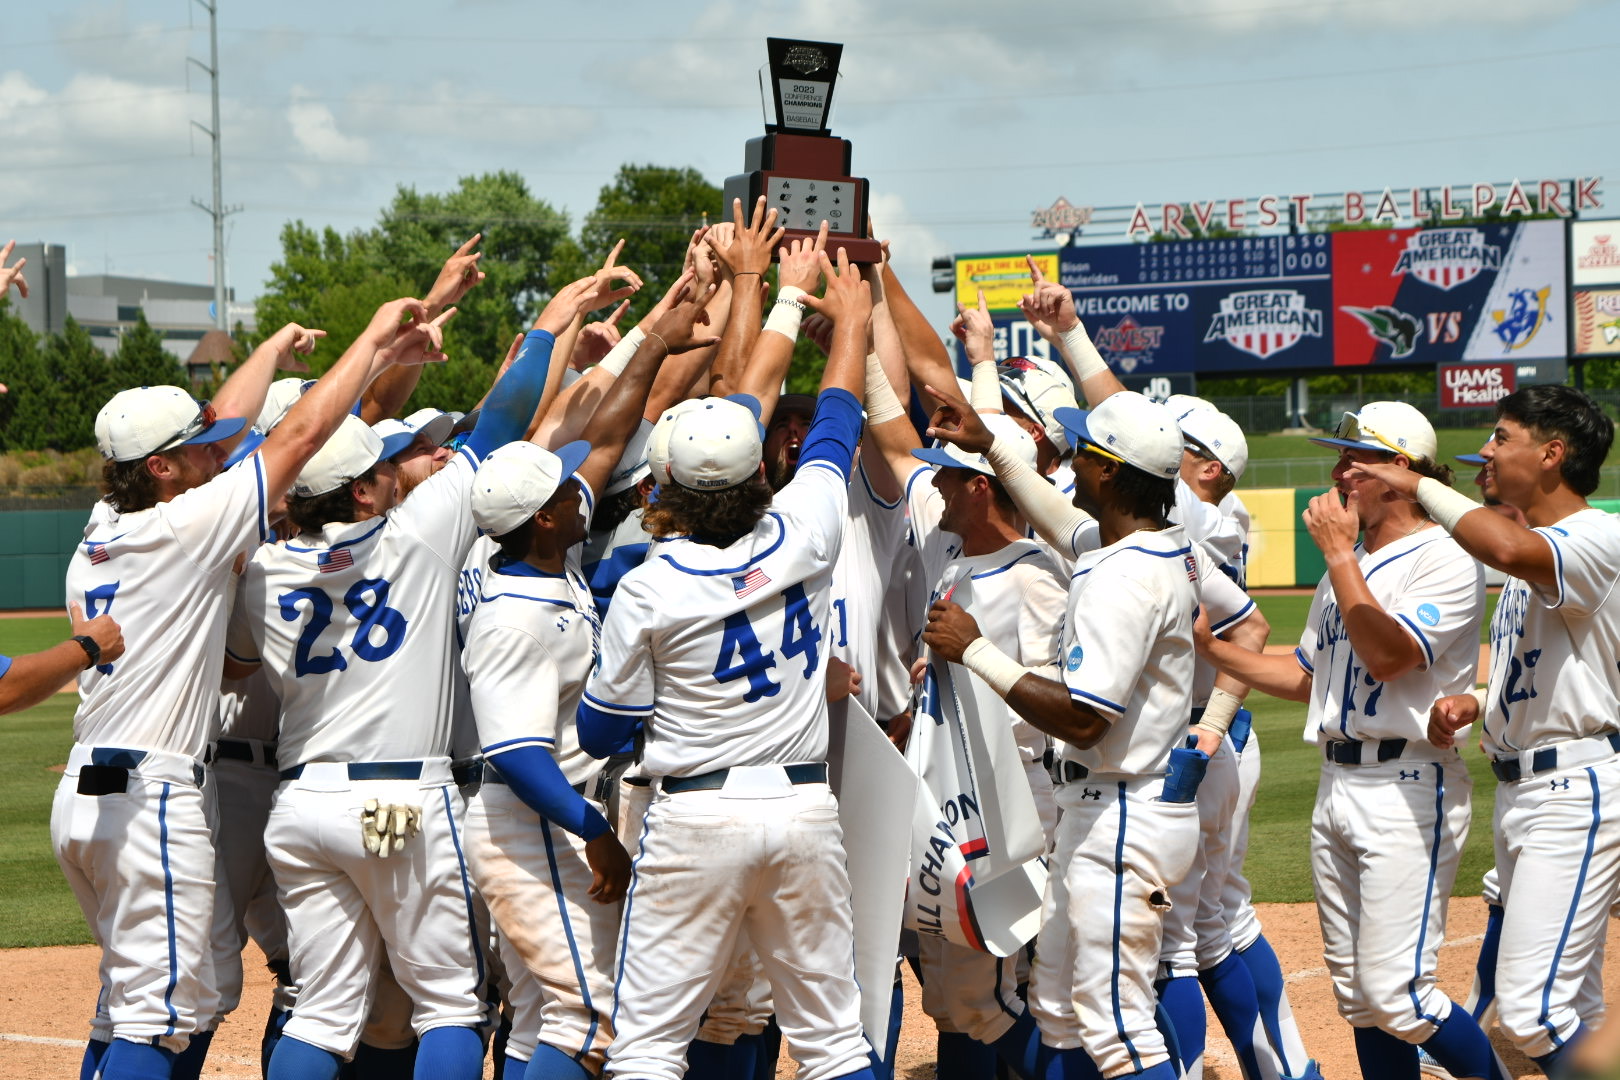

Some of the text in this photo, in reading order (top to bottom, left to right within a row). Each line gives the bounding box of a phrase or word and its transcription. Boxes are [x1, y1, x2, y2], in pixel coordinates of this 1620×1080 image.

[784, 93, 823, 101] CONFERENCE
[793, 85, 815, 94] 2023
[784, 100, 823, 108] CHAMPIONS
[786, 115, 819, 124] BASEBALL
[1126, 175, 1603, 238] ARVEST BALLPARK
[1287, 236, 1296, 249] B
[1301, 235, 1310, 248] S
[1418, 231, 1473, 247] GREAT
[1061, 262, 1090, 273] Bison
[1286, 252, 1327, 270] 0 0 0
[1392, 246, 1500, 275] AMERICAN
[1061, 274, 1119, 285] Muleriders
[1075, 293, 1189, 315] WELCOME TO
[1233, 294, 1293, 310] GREAT
[1204, 309, 1322, 341] AMERICAN
[1427, 311, 1462, 344] VS
[1095, 326, 1164, 351] ARVEST
[1445, 368, 1503, 388] UAMS
[1453, 384, 1510, 403] Health
[278, 578, 408, 678] 28
[831, 598, 848, 646] 1
[712, 581, 823, 703] 44
[919, 793, 980, 896] CHAMON
[917, 903, 947, 940] ALL
